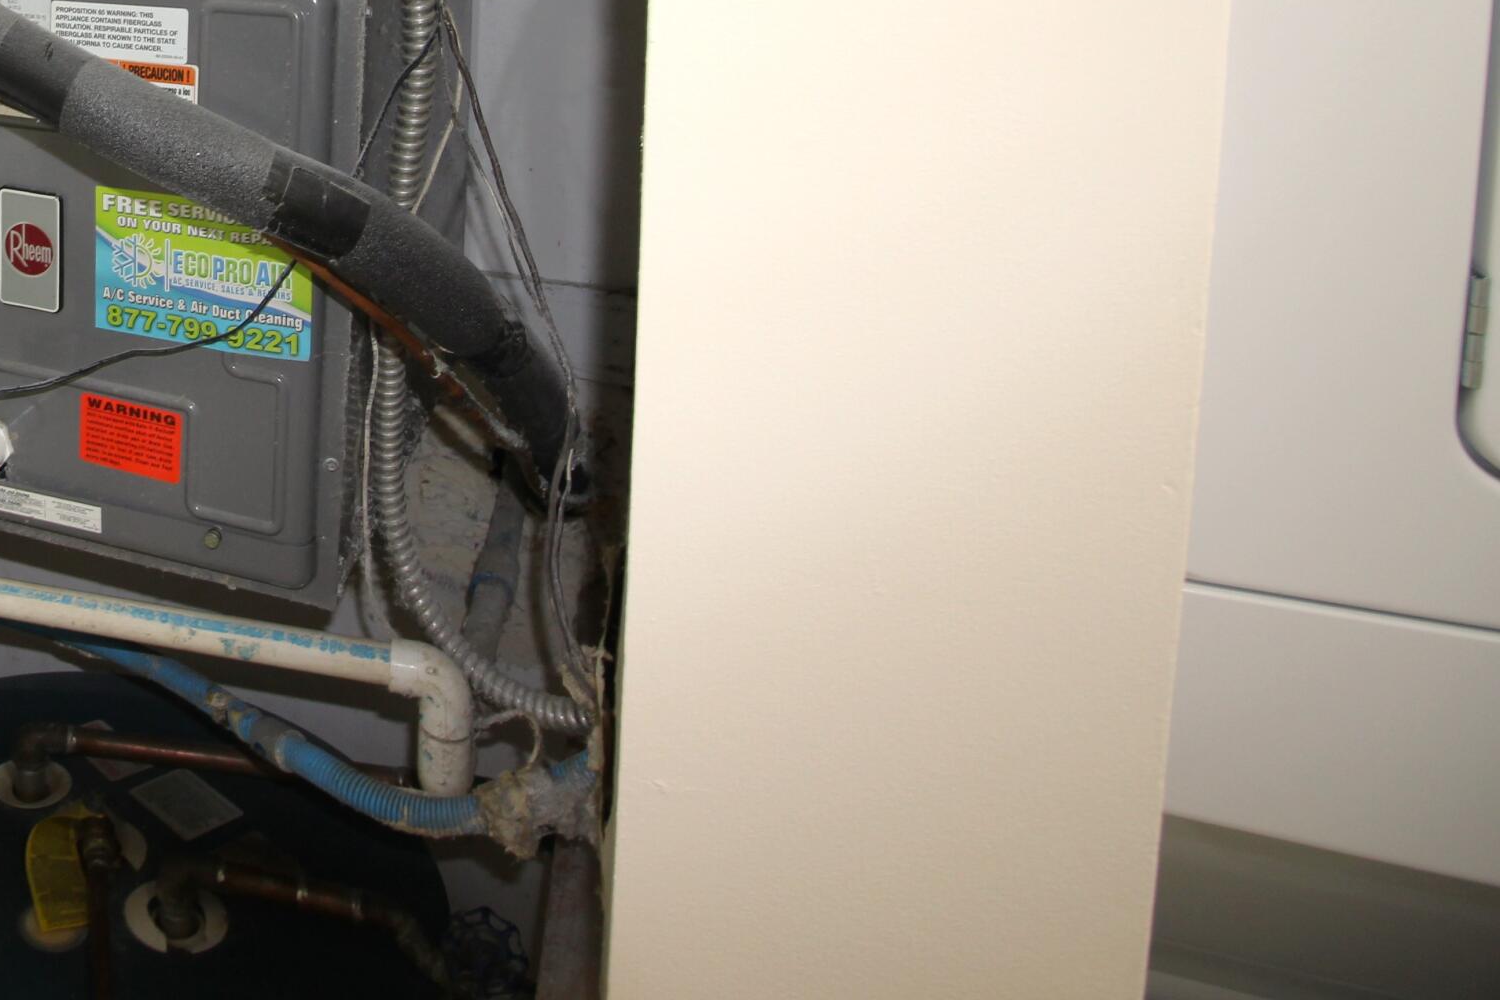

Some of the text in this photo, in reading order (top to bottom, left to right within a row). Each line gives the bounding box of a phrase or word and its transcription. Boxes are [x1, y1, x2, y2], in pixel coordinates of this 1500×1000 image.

[55, 6, 97, 15] PROPOSITION
[139, 11, 154, 19] THIS
[55, 14, 162, 28] APPLIANCE CONTAINS FIBERGLASS
[93, 32, 107, 40] ARE
[107, 34, 132, 42] KNOWN
[143, 36, 156, 44] THE
[156, 37, 176, 45] STATE
[94, 25, 132, 34] RESPIRABLE
[133, 28, 168, 36] PARTICLES
[102, 41, 111, 49] TO
[112, 42, 134, 50] CAUSE
[102, 193, 164, 218] FREE
[117, 216, 137, 228] ON
[143, 219, 182, 234] YOUR
[187, 225, 226, 241] NEXT
[8, 223, 51, 268] Rheem
[172, 277, 183, 286] AC
[221, 284, 245, 296] SALES
[103, 287, 125, 300] A/C
[128, 290, 174, 309] Service
[177, 299, 187, 311] &
[190, 301, 209, 315] Air
[212, 304, 241, 320] Duct
[106, 303, 300, 356] 877-7999221
[87, 397, 176, 426] WARNING
